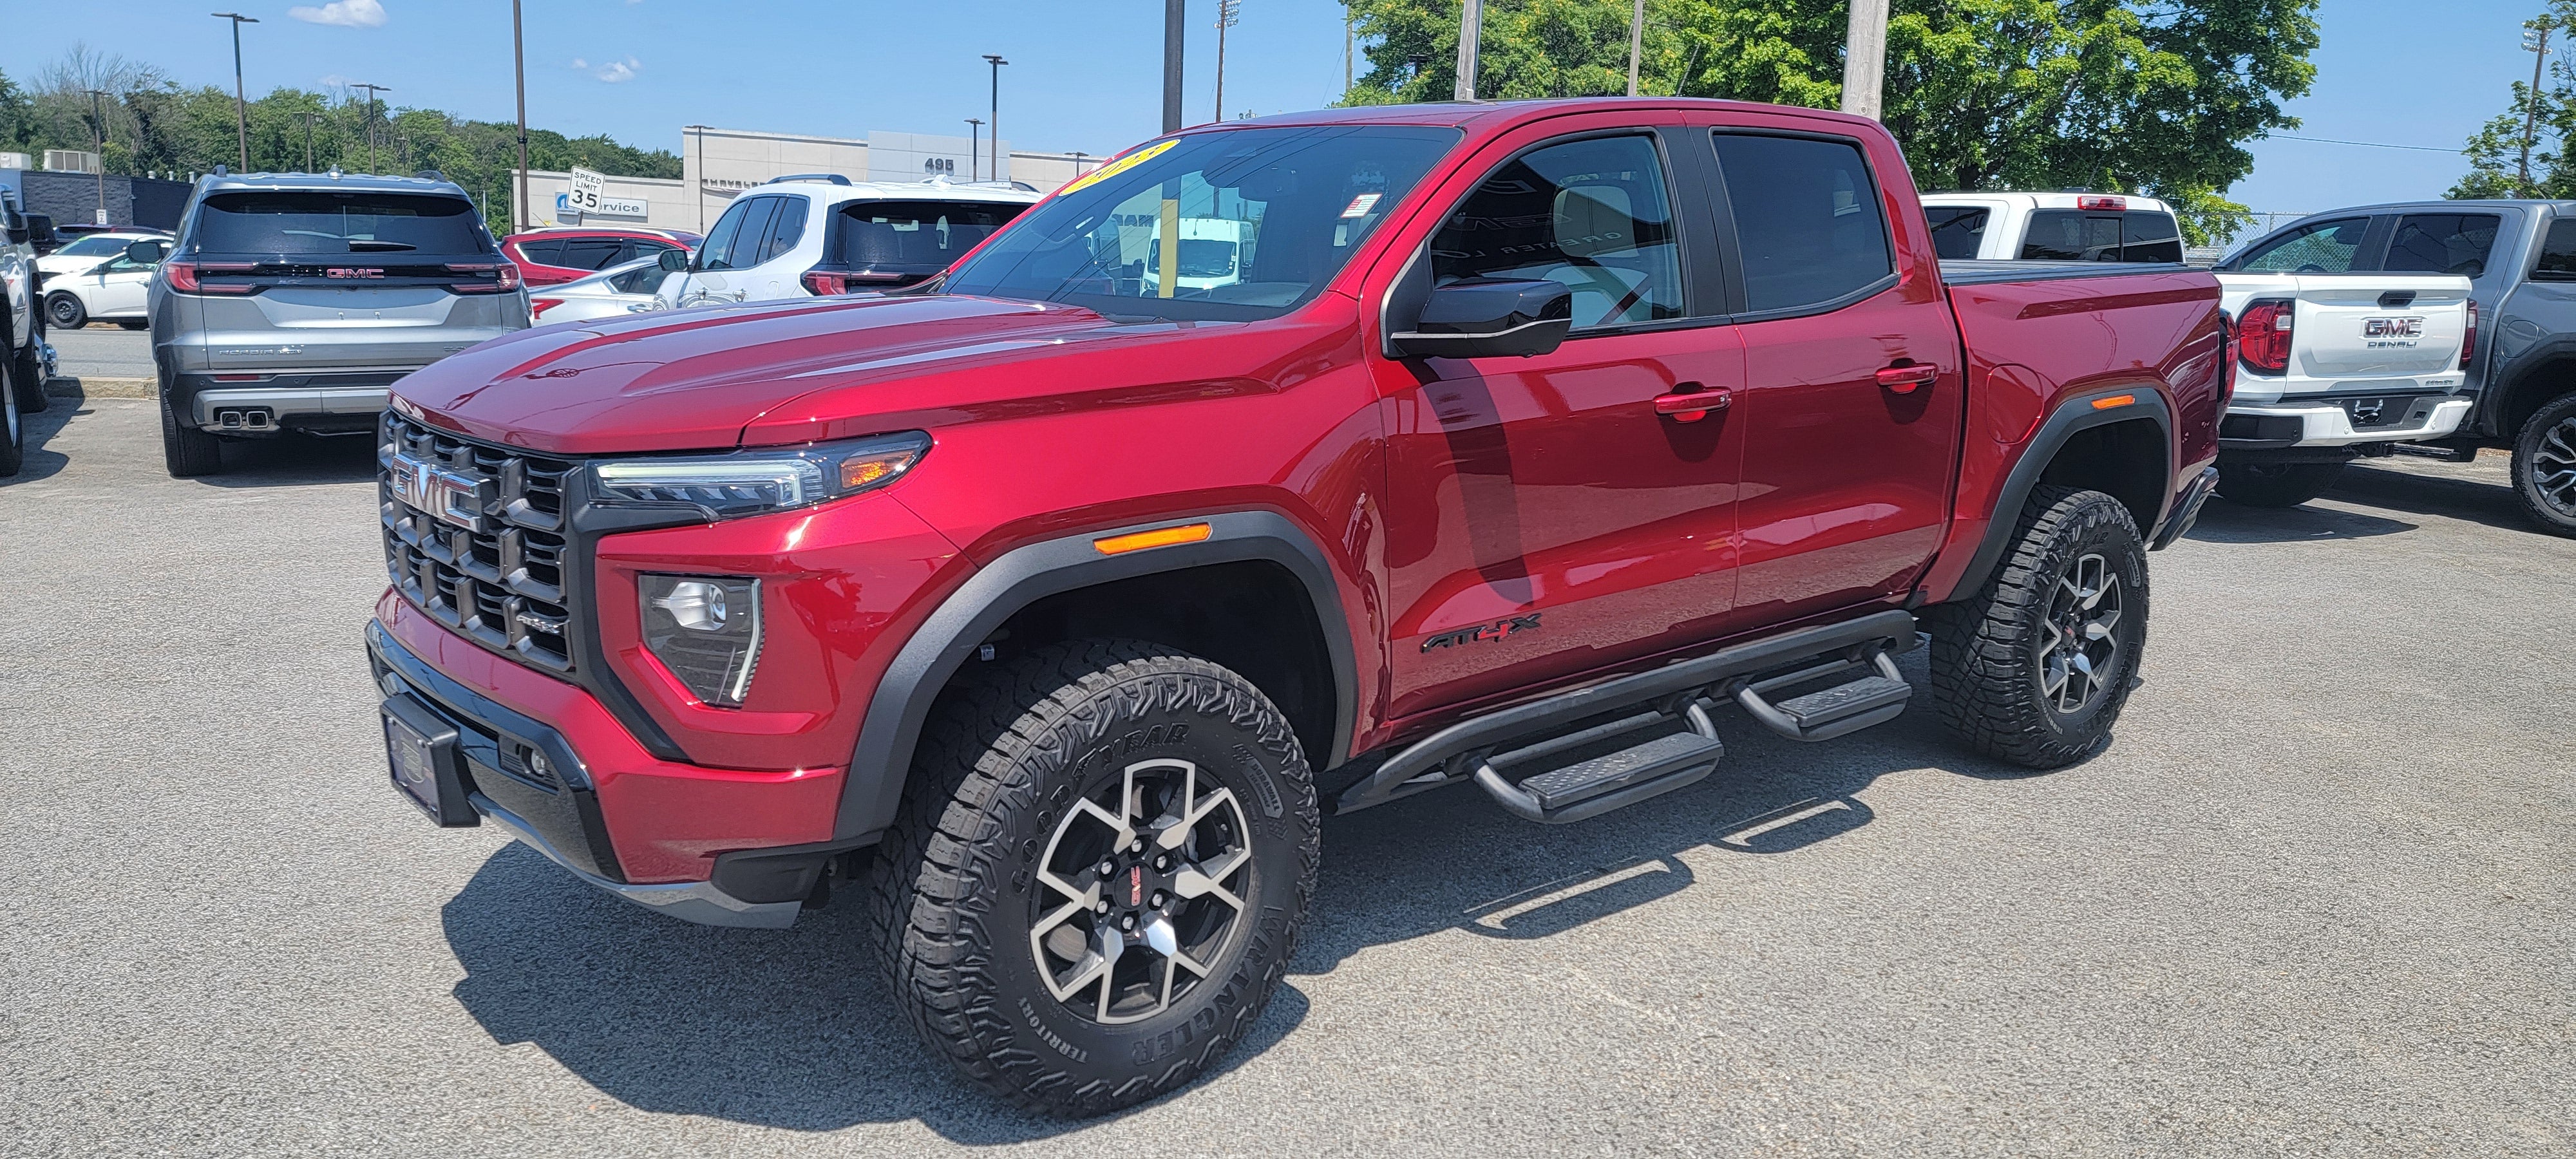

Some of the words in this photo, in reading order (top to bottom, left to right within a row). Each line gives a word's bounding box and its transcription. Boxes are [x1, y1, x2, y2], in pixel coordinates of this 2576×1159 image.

[925, 158, 954, 174] 495
[574, 171, 601, 185] SPEED
[576, 181, 598, 191] LIMIT
[702, 178, 766, 189] CHRYSLE
[572, 189, 598, 208] 35
[600, 202, 639, 212] rvice
[327, 268, 385, 279] GMC
[2363, 319, 2423, 338] GMC
[390, 453, 482, 534] GMC
[1420, 613, 1542, 654] AT4X
[1131, 865, 1141, 906] GMC
[1132, 905, 1285, 1066] WRANGLER
[1017, 997, 1088, 1064] TERRITORY
